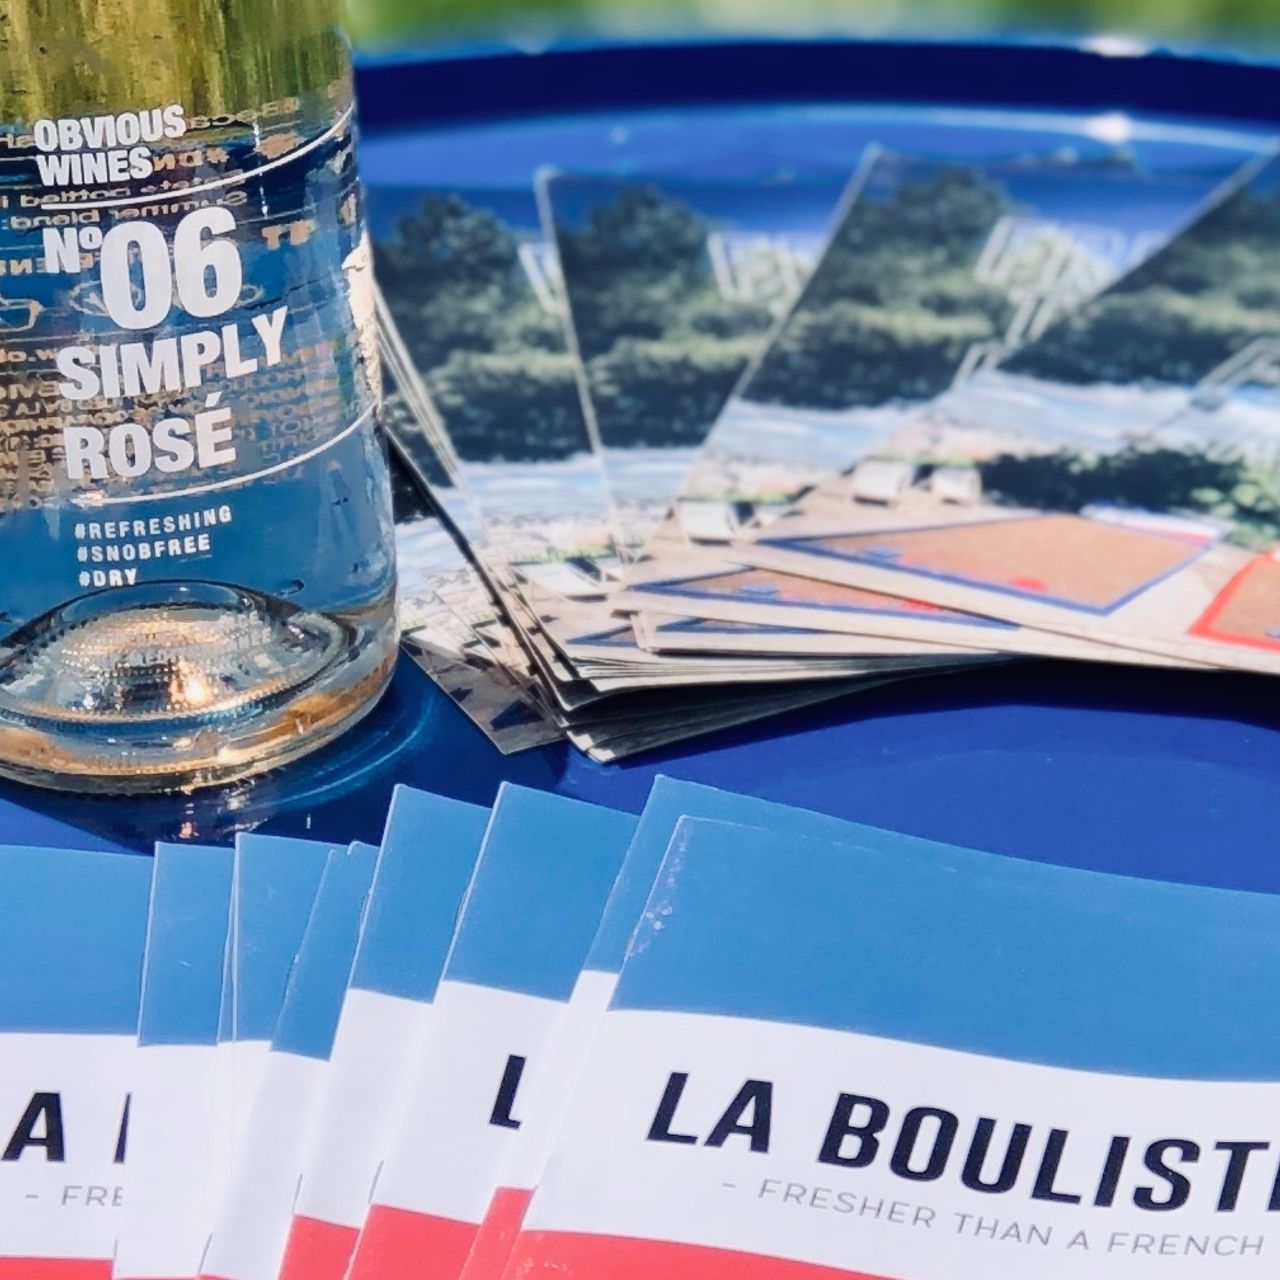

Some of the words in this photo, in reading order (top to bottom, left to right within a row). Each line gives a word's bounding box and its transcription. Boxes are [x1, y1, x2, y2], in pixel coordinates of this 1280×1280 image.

[33, 104, 188, 153] OBVIOUS
[36, 147, 154, 187] WINES
[56, 305, 289, 401] SIMPLY
[62, 391, 237, 480] ROSÉ
[74, 504, 233, 540] #REFRESHING
[77, 533, 211, 563] #SNOBFREE
[78, 567, 138, 588] #DRY
[644, 1070, 774, 1154] LA
[757, 1177, 937, 1229] FRESHER
[954, 1211, 1054, 1248] THAN
[1066, 1227, 1091, 1252] A
[1106, 1229, 1265, 1257] FRENCH
